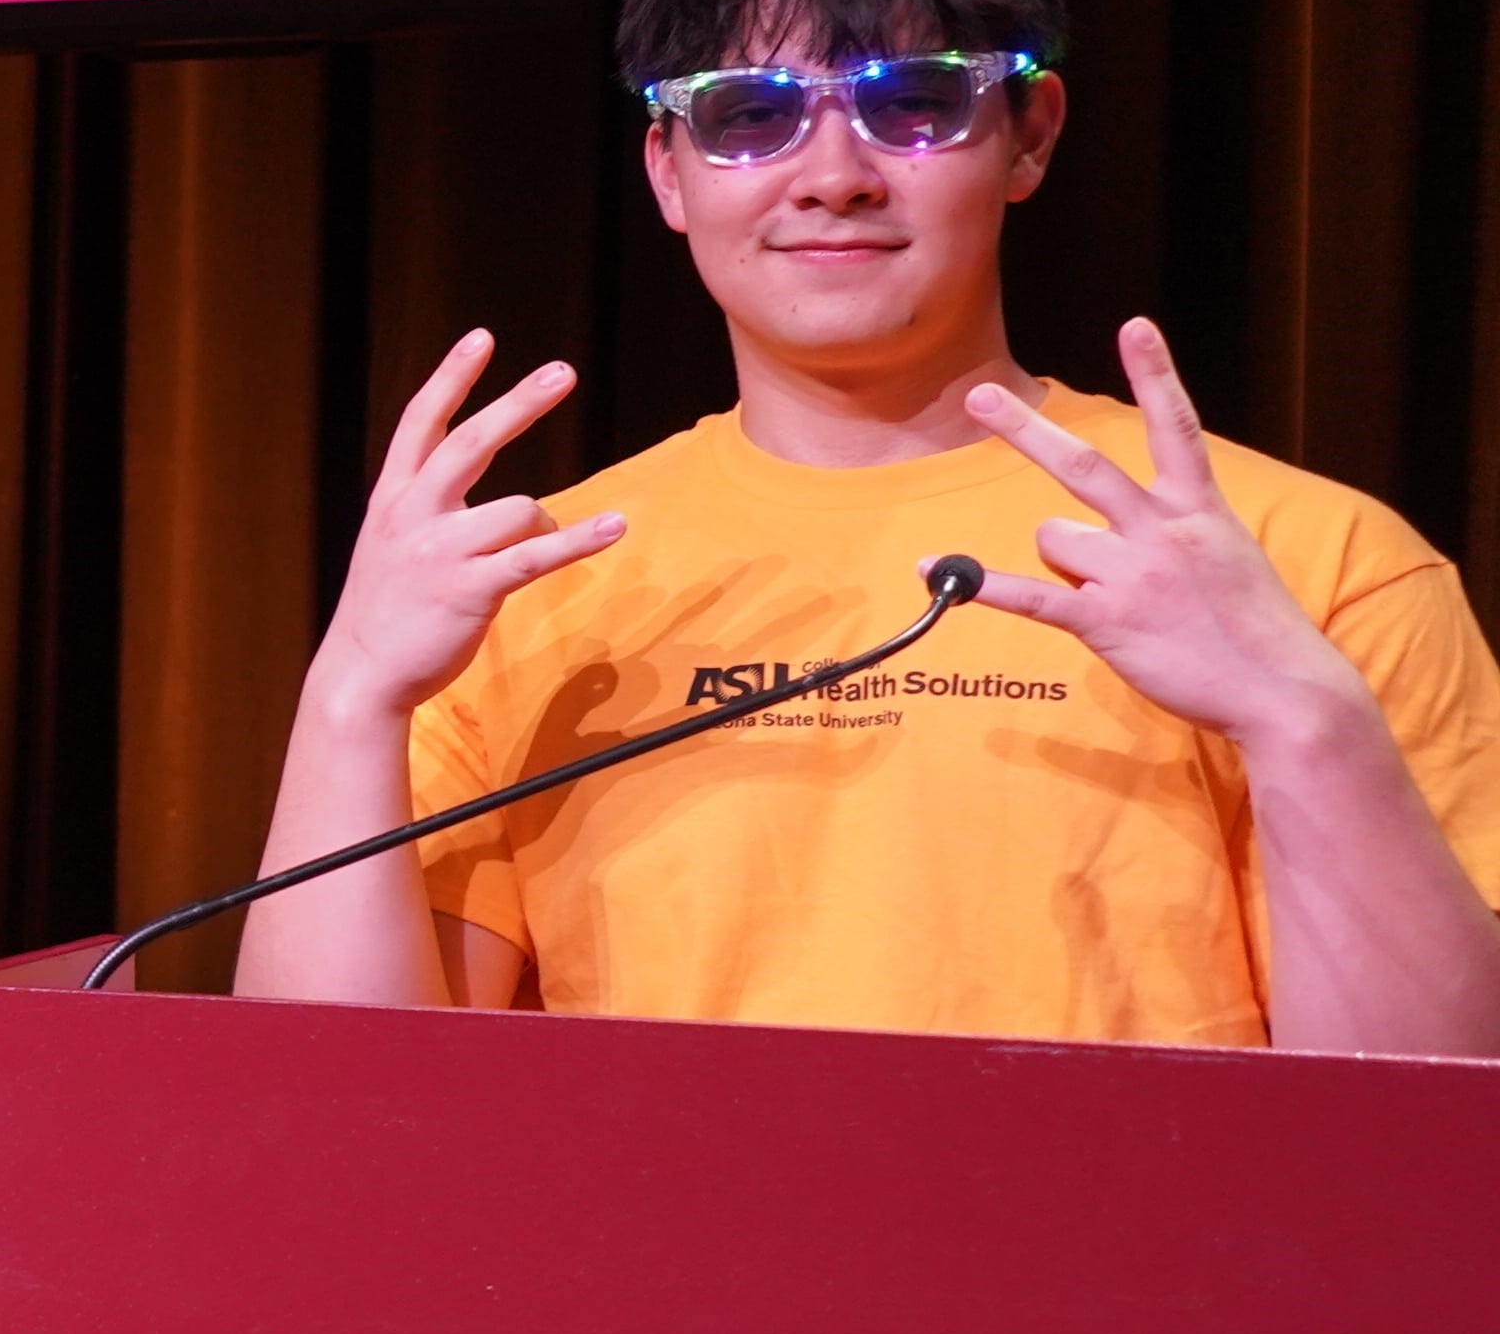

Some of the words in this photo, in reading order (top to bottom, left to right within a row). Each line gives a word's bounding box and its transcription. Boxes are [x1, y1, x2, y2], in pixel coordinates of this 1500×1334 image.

[902, 671, 1068, 701] Solutions
[761, 713, 814, 727] State
[819, 710, 904, 729] University
